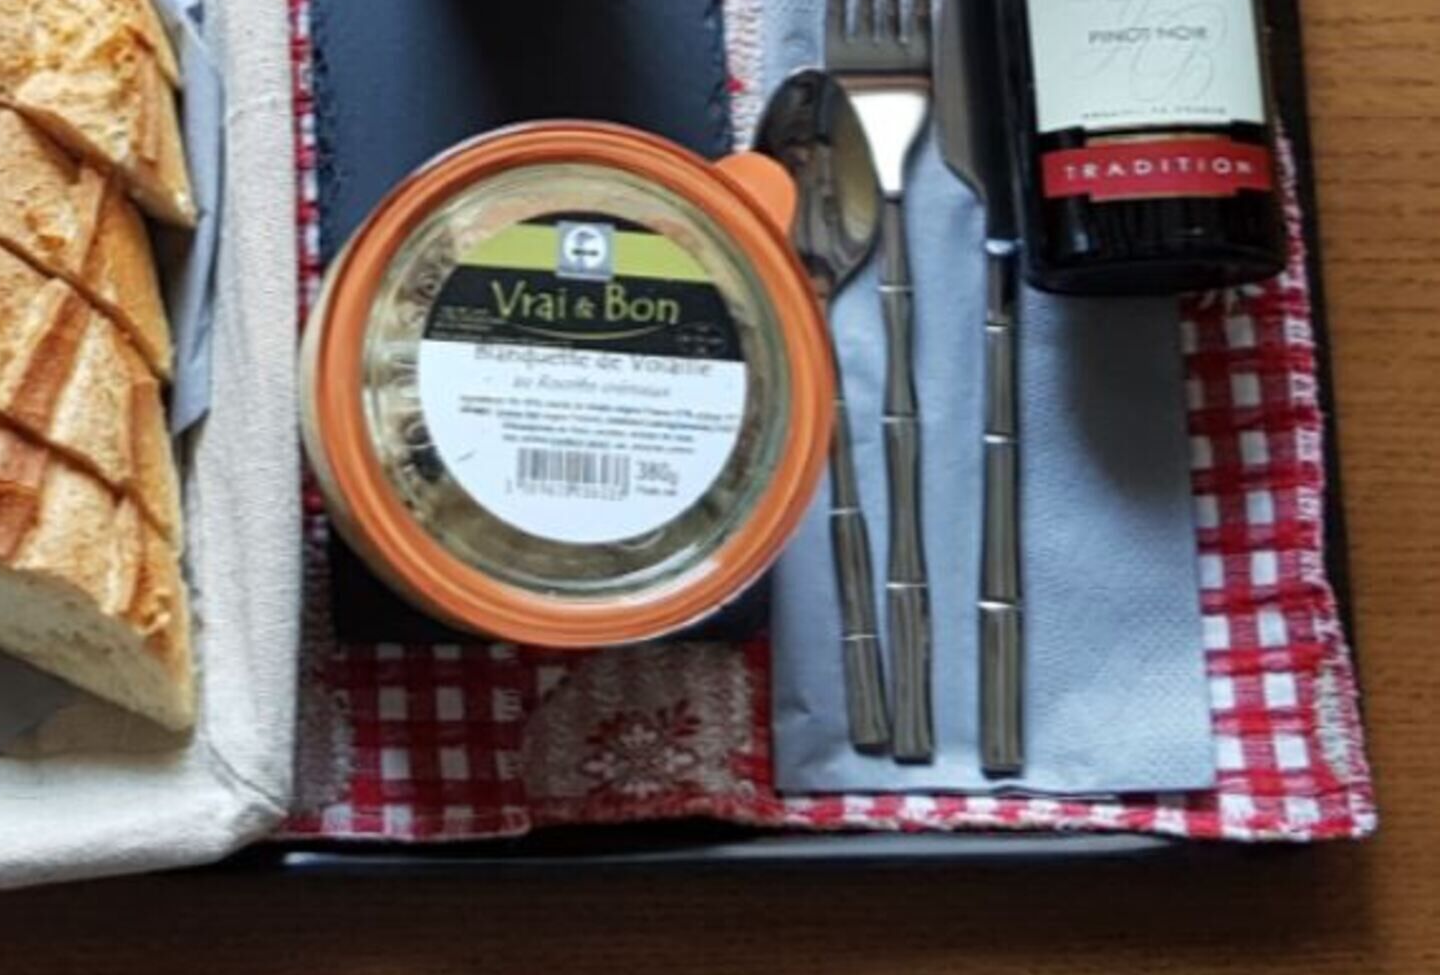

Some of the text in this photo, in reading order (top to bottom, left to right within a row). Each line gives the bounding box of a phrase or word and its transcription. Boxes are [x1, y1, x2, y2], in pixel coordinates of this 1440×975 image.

[1063, 155, 1254, 181] TRADITION
[491, 279, 568, 322] Vrai
[604, 283, 681, 325] Bon
